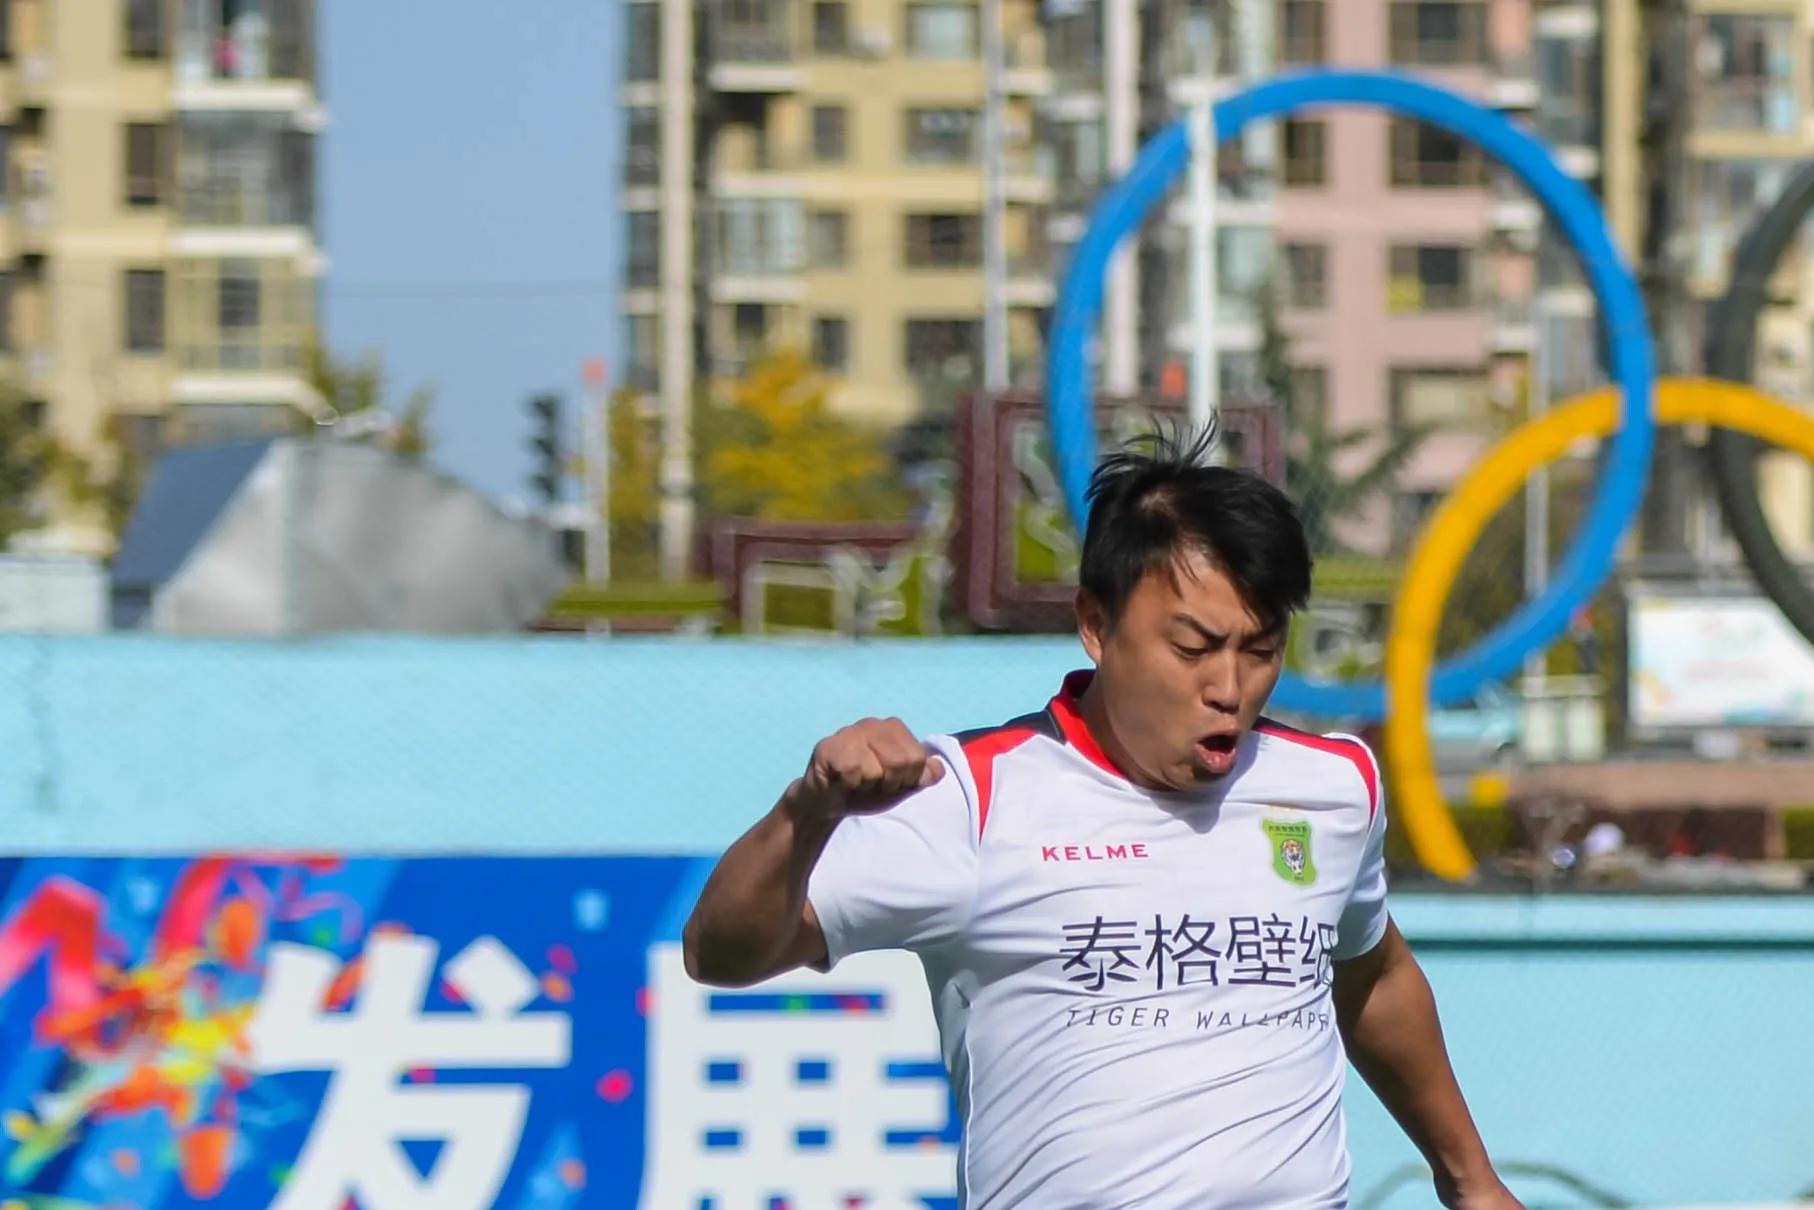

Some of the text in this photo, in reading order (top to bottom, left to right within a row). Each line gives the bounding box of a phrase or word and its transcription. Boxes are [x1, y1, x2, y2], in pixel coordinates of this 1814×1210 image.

[1041, 844, 1149, 861] KELME
[1059, 912, 1336, 991] 泰格壁纸
[1066, 1006, 1170, 1028] TIGER
